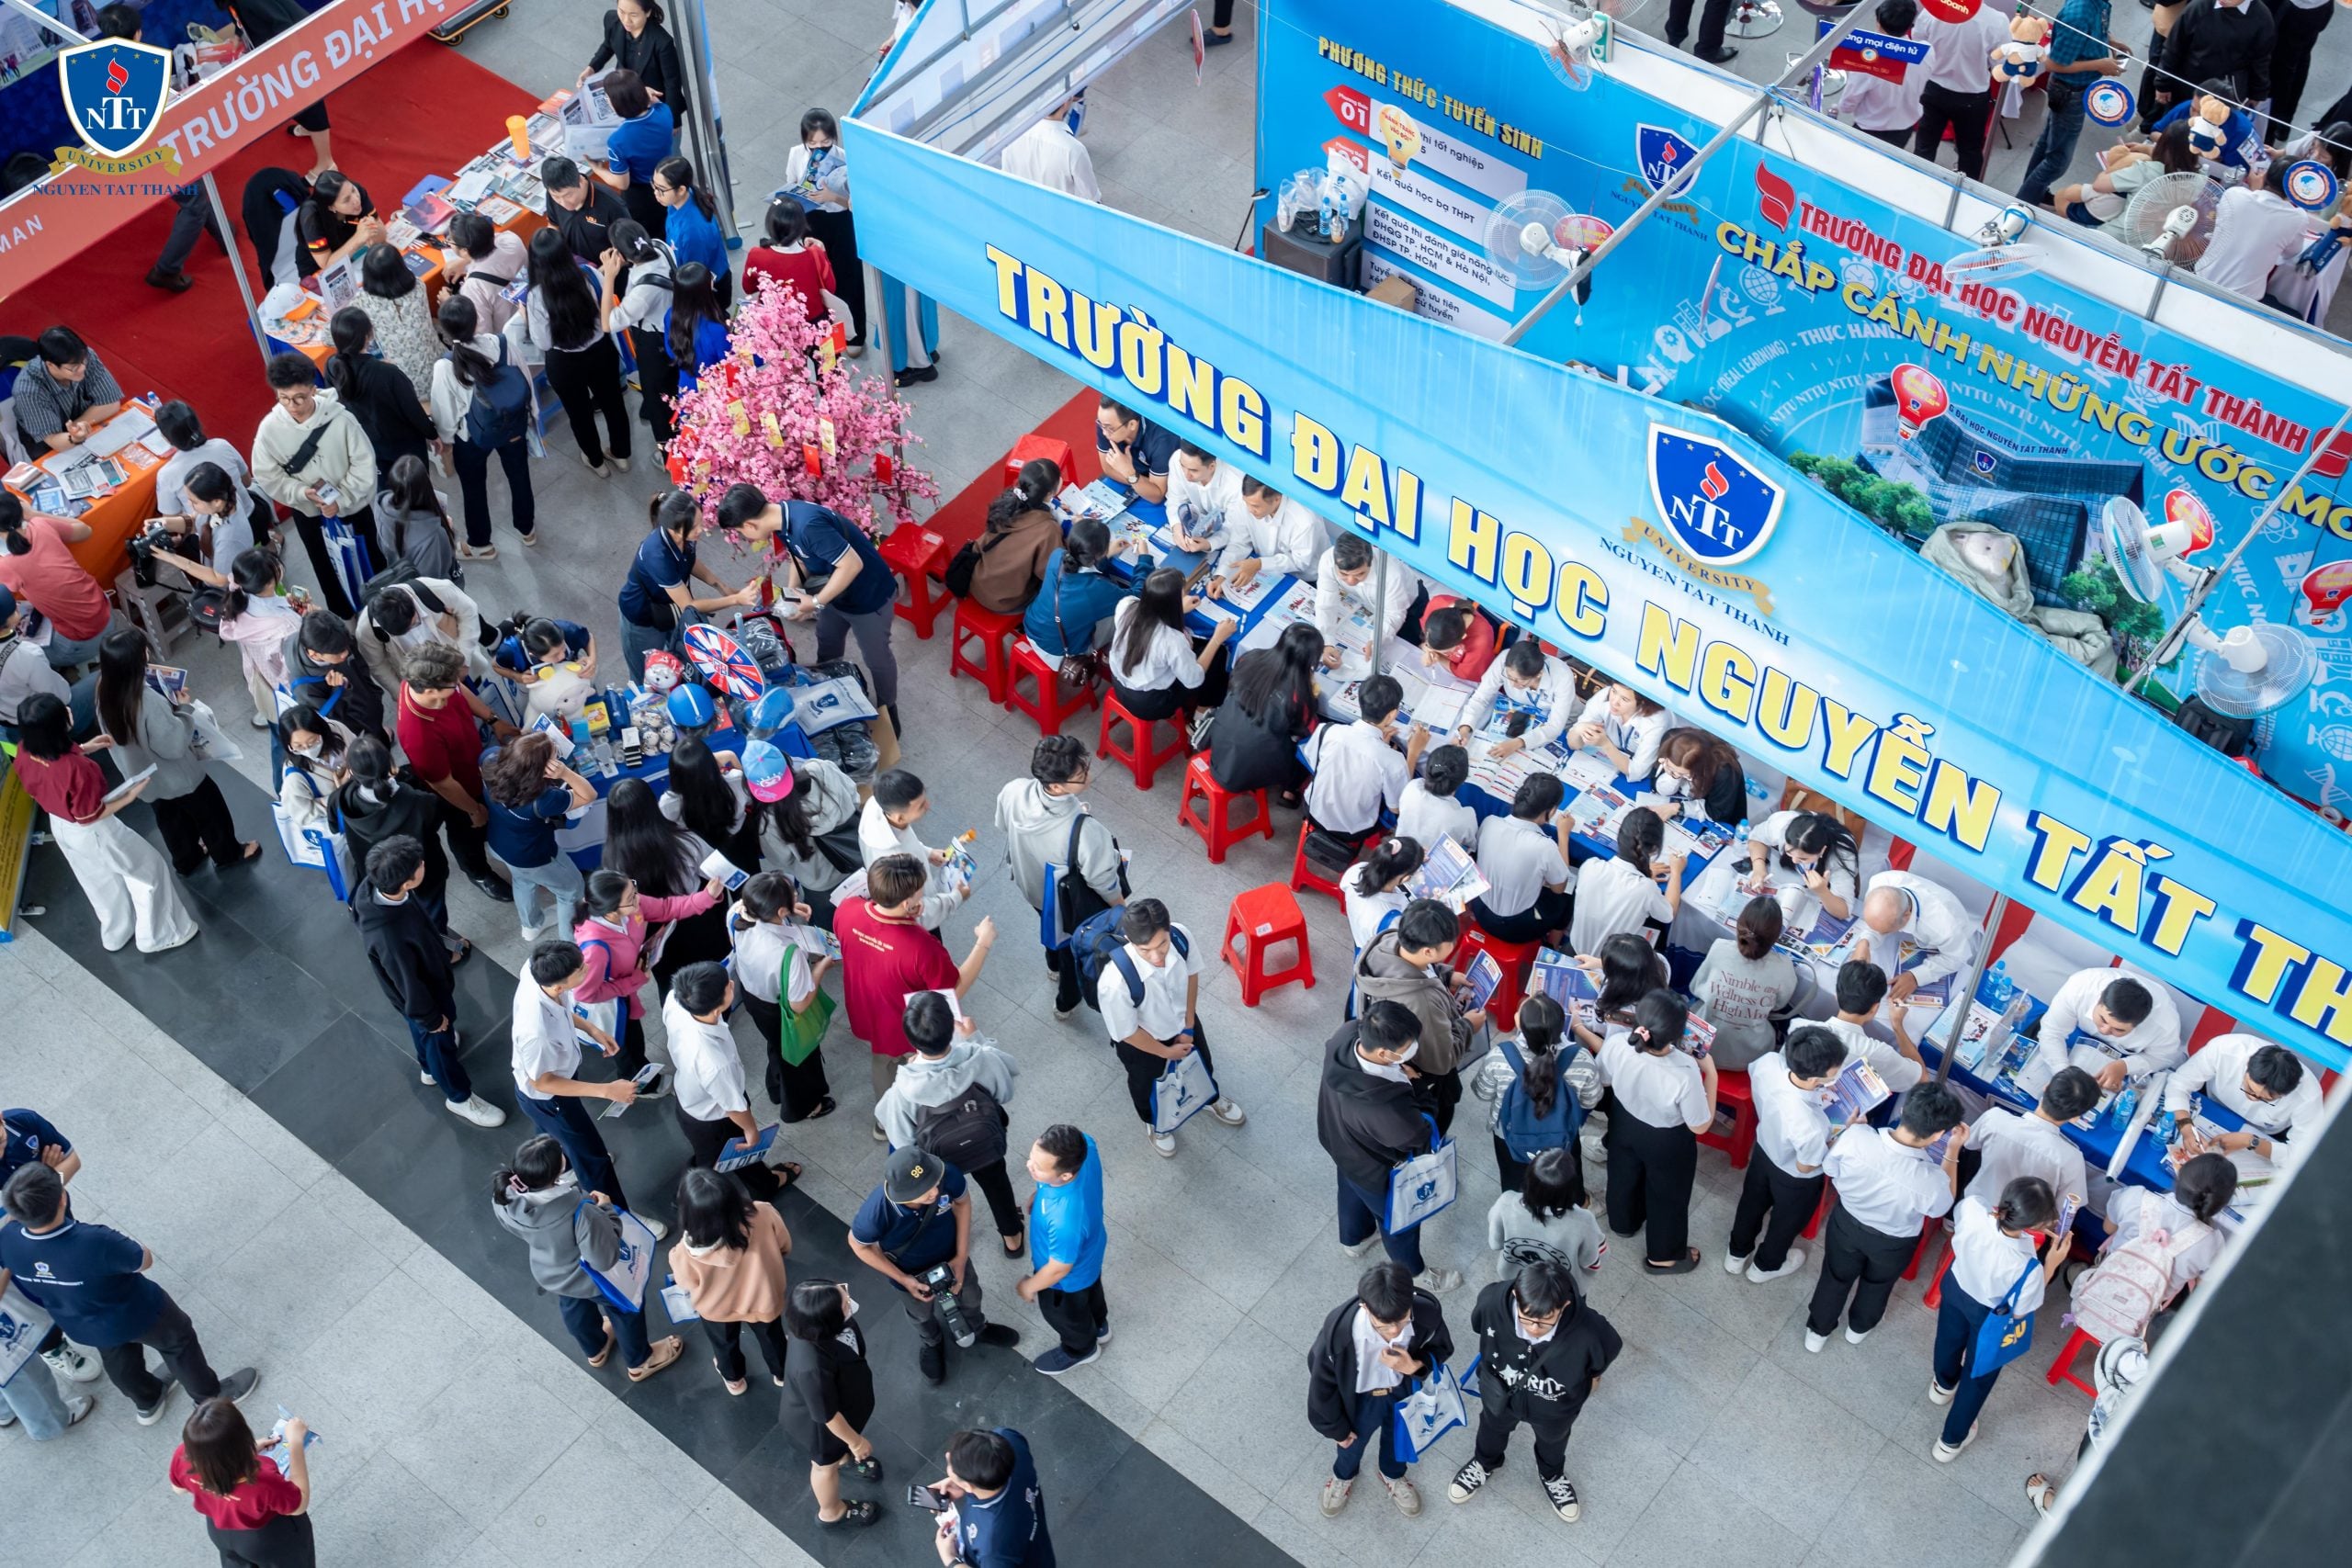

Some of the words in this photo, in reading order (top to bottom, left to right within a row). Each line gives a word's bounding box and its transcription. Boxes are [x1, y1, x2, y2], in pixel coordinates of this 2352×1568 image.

[1864, 39, 1883, 50] mại
[1884, 41, 1906, 53] điện
[157, 50, 321, 165] TRƯỜNG
[323, 6, 393, 70] ĐẠI
[1318, 36, 1387, 85] PHƯƠNG
[1393, 70, 1438, 109] THỨC
[1443, 95, 1495, 138] TUYỂN
[1498, 123, 1544, 160] SINH
[1340, 101, 1365, 128] 01
[1434, 138, 1448, 152] tốt
[1450, 149, 1485, 171] nghiệp
[1376, 168, 1392, 182] Kết
[1395, 178, 1413, 195] quả
[1416, 188, 1433, 204] học
[1436, 197, 1450, 212] bạ
[1452, 206, 1476, 224] THPT
[1372, 231, 1397, 247] ĐHSP
[1399, 243, 1412, 257] TP.
[1415, 253, 1438, 270] HCM
[1374, 207, 1389, 220] Kết
[1391, 217, 1409, 232] quả
[1411, 226, 1422, 239] thi
[1425, 233, 1449, 252] đánh
[1451, 245, 1466, 261] giá
[1468, 255, 1493, 276] năng
[1374, 219, 1402, 239] ĐHQG
[1405, 234, 1418, 247] TP.
[1420, 243, 1443, 261] HCM
[1445, 256, 1453, 265] &
[1455, 261, 1469, 274] Hà
[1429, 291, 1441, 302] ưu
[1442, 299, 1460, 313] tiên
[1797, 324, 1847, 347] THỰC
[1799, 199, 1903, 273] TRƯỜNG
[1905, 251, 1955, 296] ĐẠI
[1959, 276, 2018, 324] HỌC
[2021, 304, 2141, 381] NGUYỄN
[2145, 359, 2201, 406] TẤT
[2204, 385, 2312, 455] THÀNH
[1741, 338, 1790, 375] LEARNING)
[1795, 383, 1828, 406] NTTU
[1827, 374, 1862, 391] NTTU
[1841, 282, 1972, 363] CÁNH
[1977, 344, 2154, 446] NHỮNG
[2159, 428, 2276, 500] ƯỚC
[1951, 381, 1993, 404] NTTU
[1996, 398, 2038, 425] NTTU
[1669, 494, 1744, 549] NTT
[1645, 526, 1756, 591] UNIVERSITY
[985, 243, 1272, 461] TRƯỜNG
[1290, 410, 1423, 545] ĐẠI
[1447, 495, 1610, 642] HỌC
[1636, 600, 2003, 854] NGUYỄN
[2022, 809, 2217, 957] TẤT
[1600, 536, 1678, 586] NGUYEN
[1681, 580, 1719, 607] TAT
[1723, 602, 1791, 647] THANH
[1711, 981, 1758, 1006] Wellness
[1720, 970, 1760, 992] Nimble
[1713, 998, 1742, 1020] High
